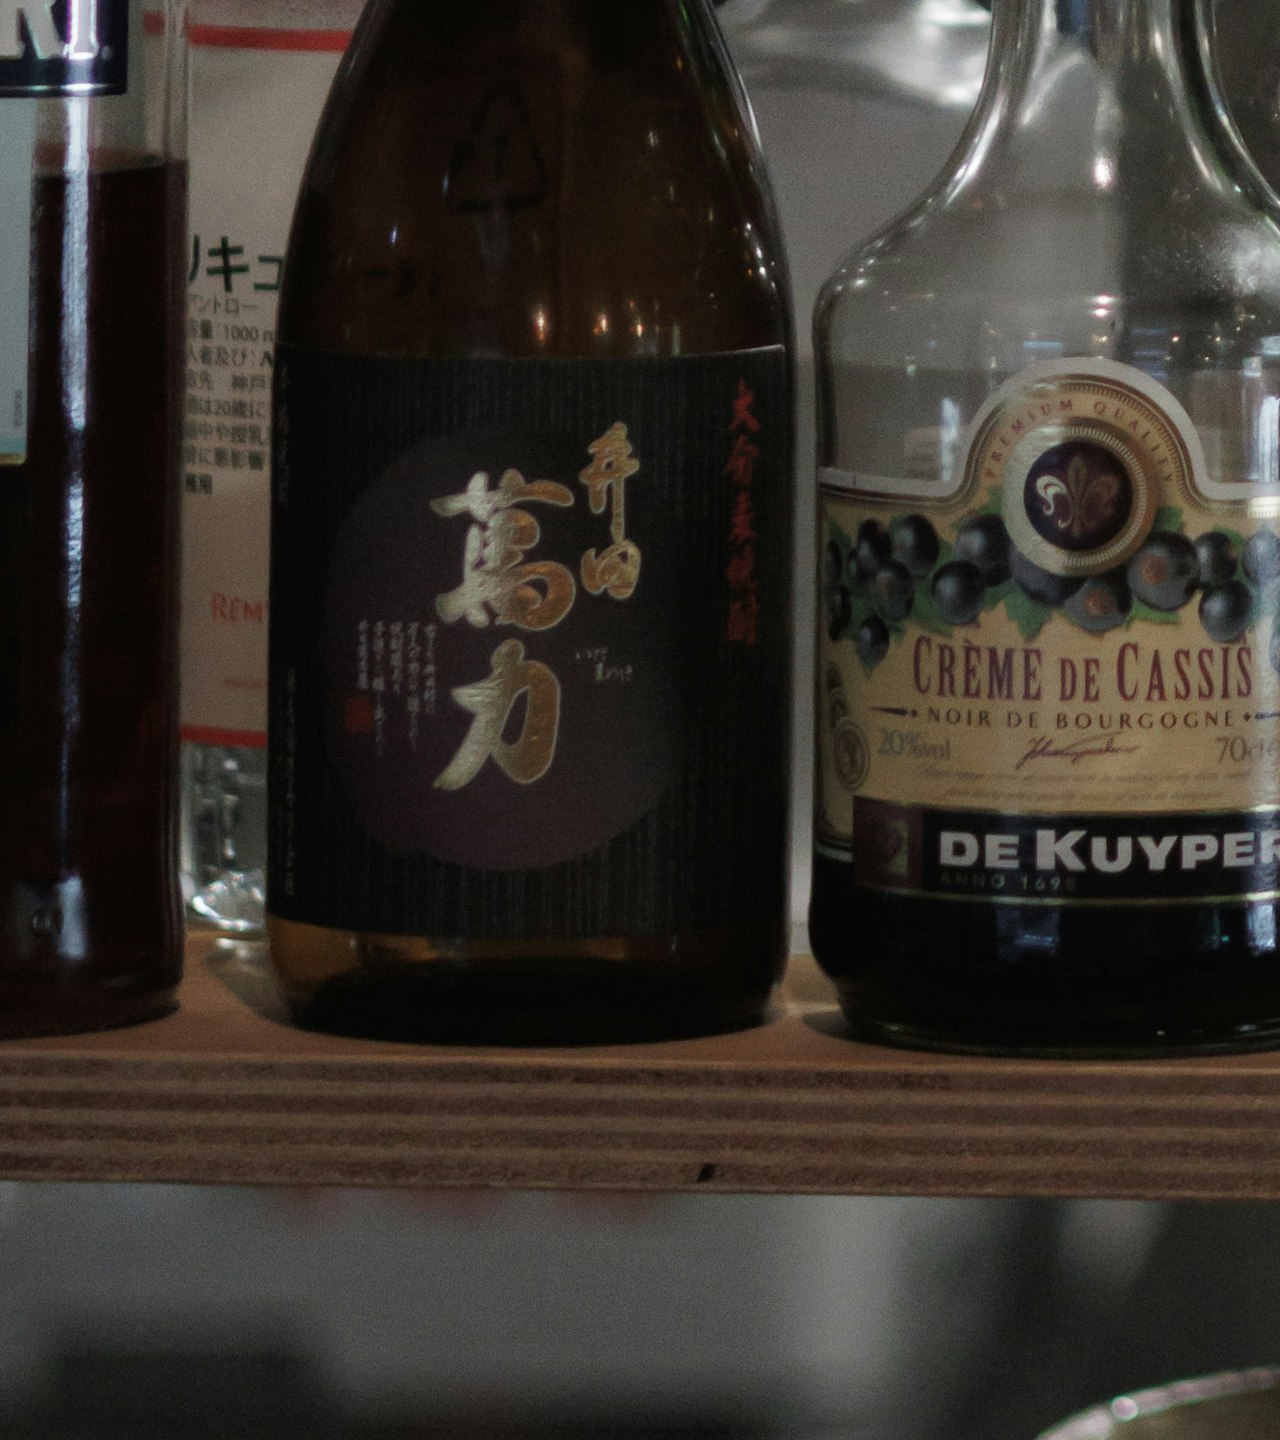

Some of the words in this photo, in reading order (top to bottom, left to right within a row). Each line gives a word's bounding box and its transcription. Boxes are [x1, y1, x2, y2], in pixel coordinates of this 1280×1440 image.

[984, 398, 1074, 479] PREMIUM
[1093, 400, 1175, 483] QUALITY
[912, 635, 1043, 703] CRÈME
[1058, 659, 1101, 703] DE
[1115, 639, 1254, 703] CASSIS
[926, 705, 994, 727] NOIR
[1005, 710, 1041, 730] DE
[1055, 709, 1236, 731] BOURGOGNE
[938, 829, 1020, 870] DE
[938, 871, 1006, 890] ANNO
